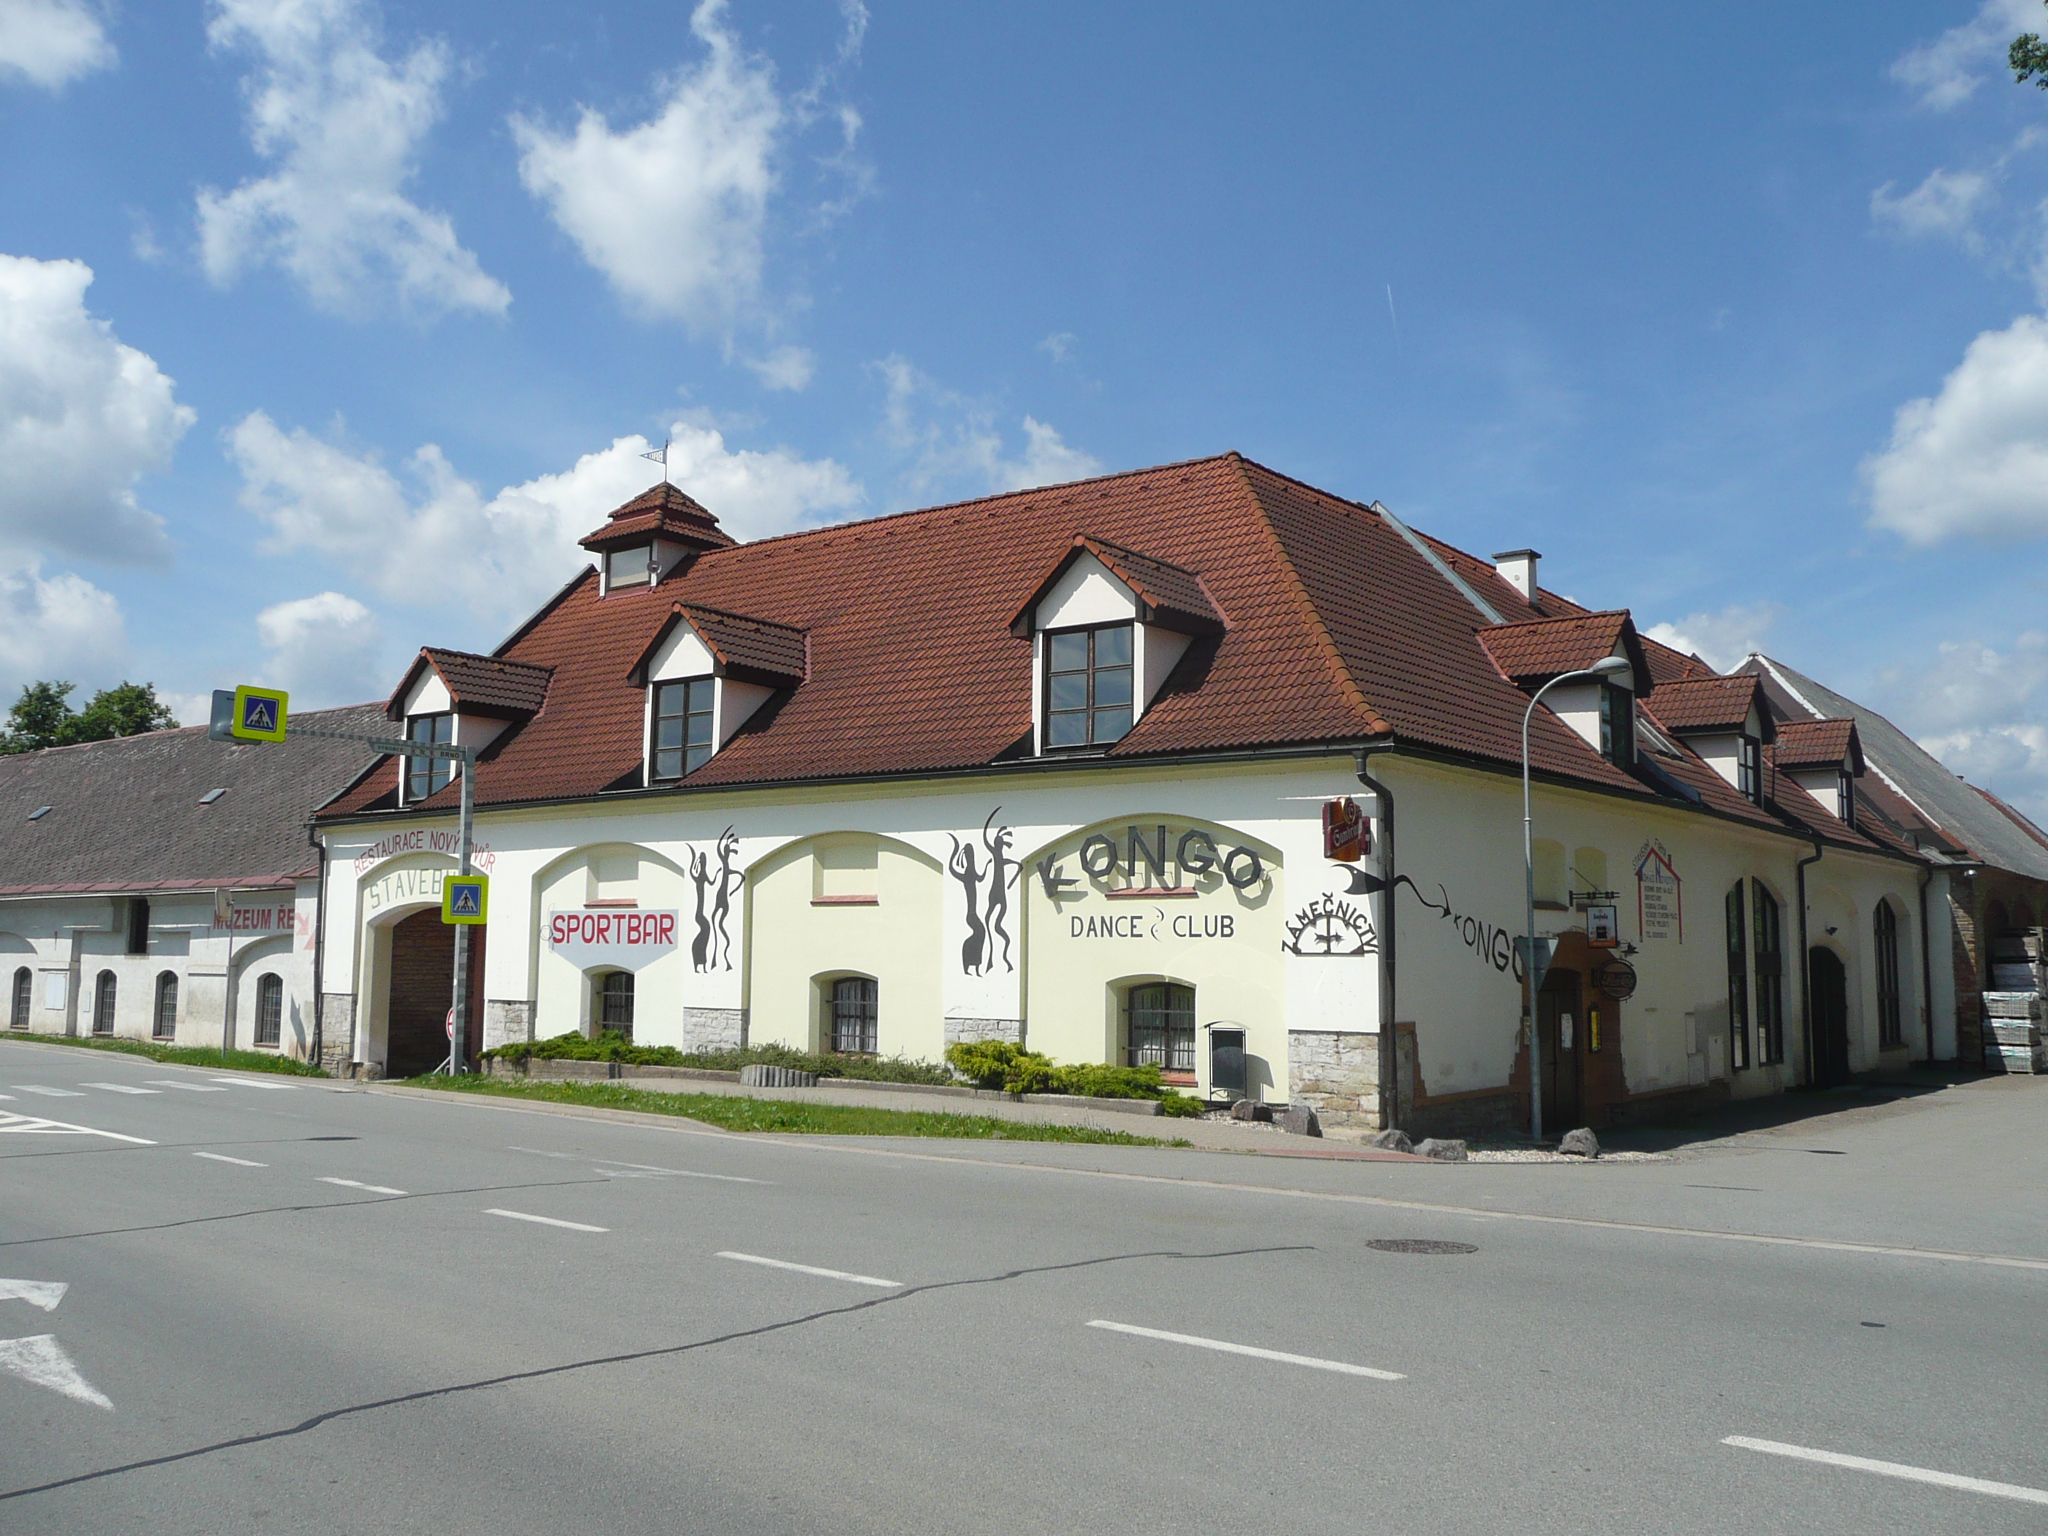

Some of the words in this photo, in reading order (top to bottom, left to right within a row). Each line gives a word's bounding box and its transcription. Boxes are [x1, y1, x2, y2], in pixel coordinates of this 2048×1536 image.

[440, 751, 460, 759] BRNO
[354, 831, 424, 876] RESTAURACE
[429, 829, 460, 854] NOVÝ
[1036, 825, 1262, 898] KONGO
[370, 868, 457, 910] STAVEB
[552, 914, 674, 945] SPORTBAR
[1071, 915, 1143, 938] DANCE
[1172, 915, 1235, 938] CLUB
